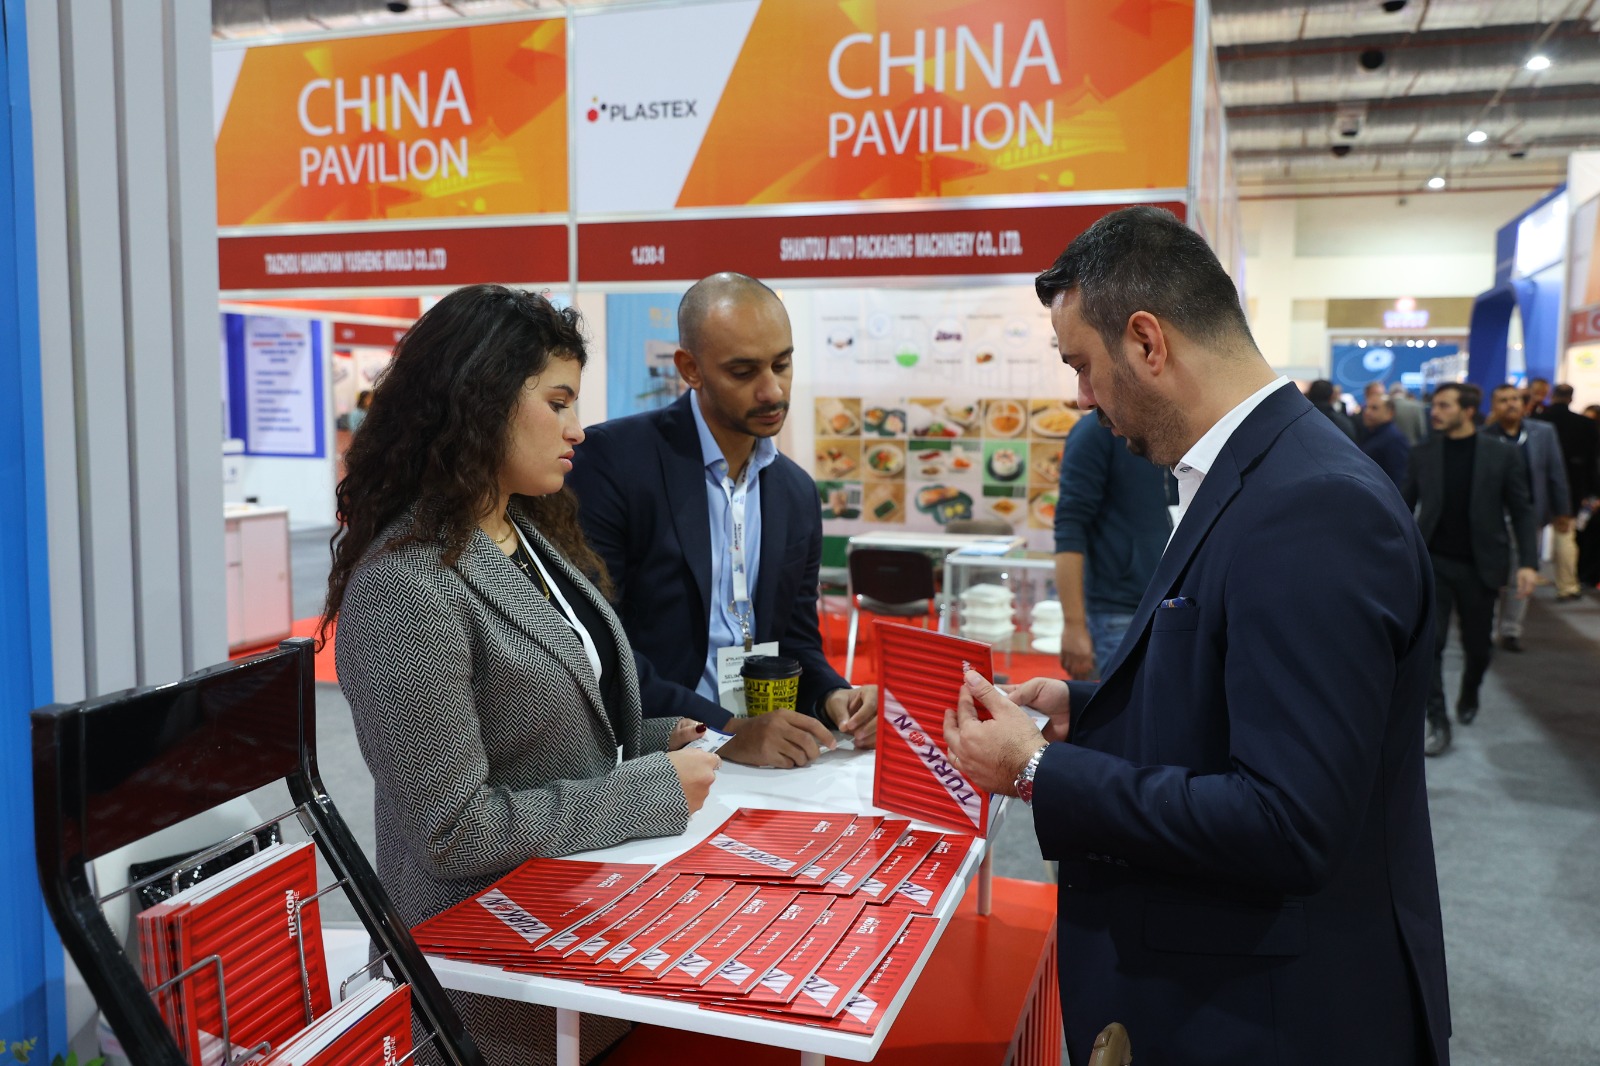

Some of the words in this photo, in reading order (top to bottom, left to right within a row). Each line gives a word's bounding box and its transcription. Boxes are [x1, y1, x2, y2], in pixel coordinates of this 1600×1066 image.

[828, 19, 1062, 99] CHINA
[298, 68, 472, 136] CHINA
[609, 99, 697, 121] PLASTEX
[829, 100, 1054, 158] PAVILION
[300, 137, 468, 187] PAVILION
[780, 236, 827, 261] SHANTOU
[827, 236, 855, 260] AUTO
[856, 234, 914, 259] PACKAGING
[914, 232, 976, 258] MACHINERY
[999, 230, 1023, 256] LTD.
[285, 889, 298, 938] TURKON
